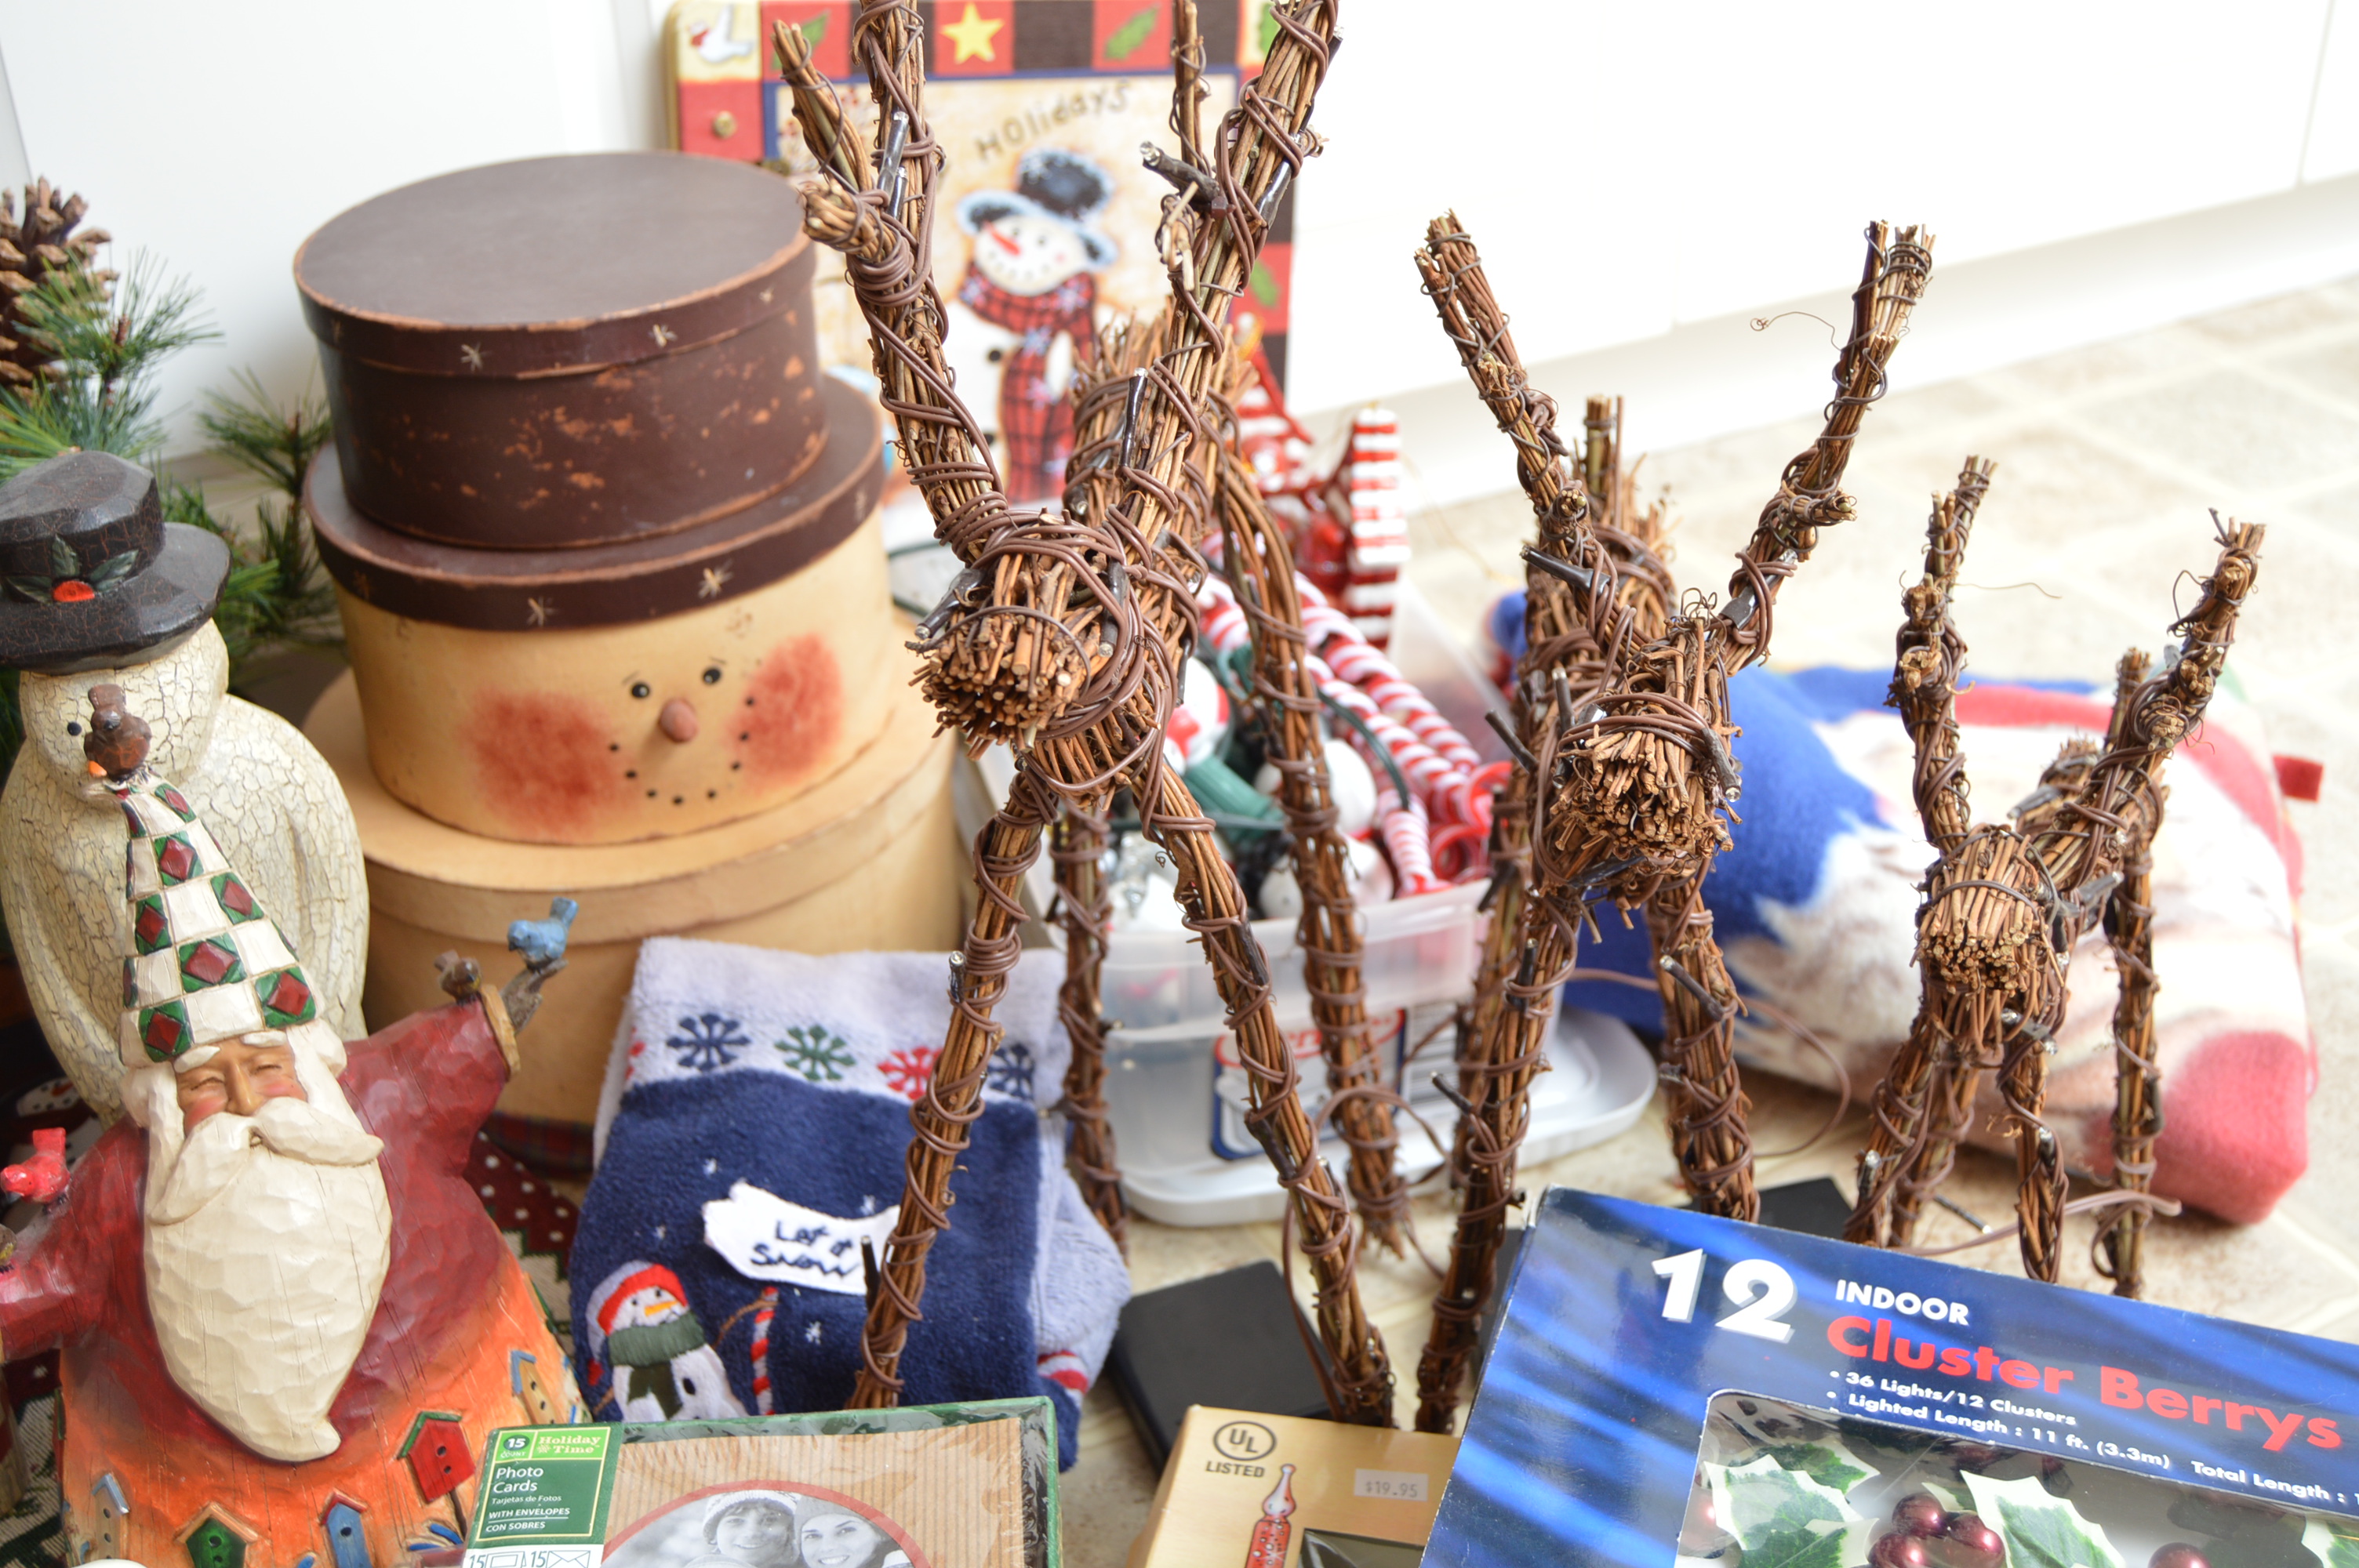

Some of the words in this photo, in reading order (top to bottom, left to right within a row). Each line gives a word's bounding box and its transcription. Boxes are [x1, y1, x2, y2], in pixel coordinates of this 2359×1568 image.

[1651, 1247, 1798, 1344] 12
[1835, 1279, 1969, 1327] INDOOR
[1826, 1316, 2074, 1395] Cluster
[2100, 1365, 2343, 1452] Berrys
[1845, 1371, 1874, 1388] 36
[1880, 1378, 1984, 1408] Lights/12
[1990, 1399, 2077, 1426] Clusters
[507, 1438, 526, 1448] 15
[539, 1436, 602, 1446] Holiday
[1228, 1427, 1259, 1454] UL
[1848, 1393, 1928, 1419] Lighted
[2031, 1427, 2057, 1443] 11
[2065, 1432, 2090, 1451] ft.
[2096, 1440, 2170, 1469] (3.3m)
[2190, 1460, 2246, 1483] Total
[500, 1450, 526, 1459] COUNT
[496, 1466, 544, 1479] Photo
[1205, 1460, 1266, 1479] LISTED
[493, 1479, 538, 1494] Cards
[1365, 1480, 1418, 1498] $19.95
[492, 1496, 524, 1505] Tarjetas
[489, 1508, 514, 1519] WITH
[515, 1507, 571, 1517] ENVELOPES
[485, 1523, 507, 1533] CON
[508, 1521, 546, 1530] SOBRES
[470, 1554, 486, 1568] 15
[530, 1550, 547, 1568] 15
